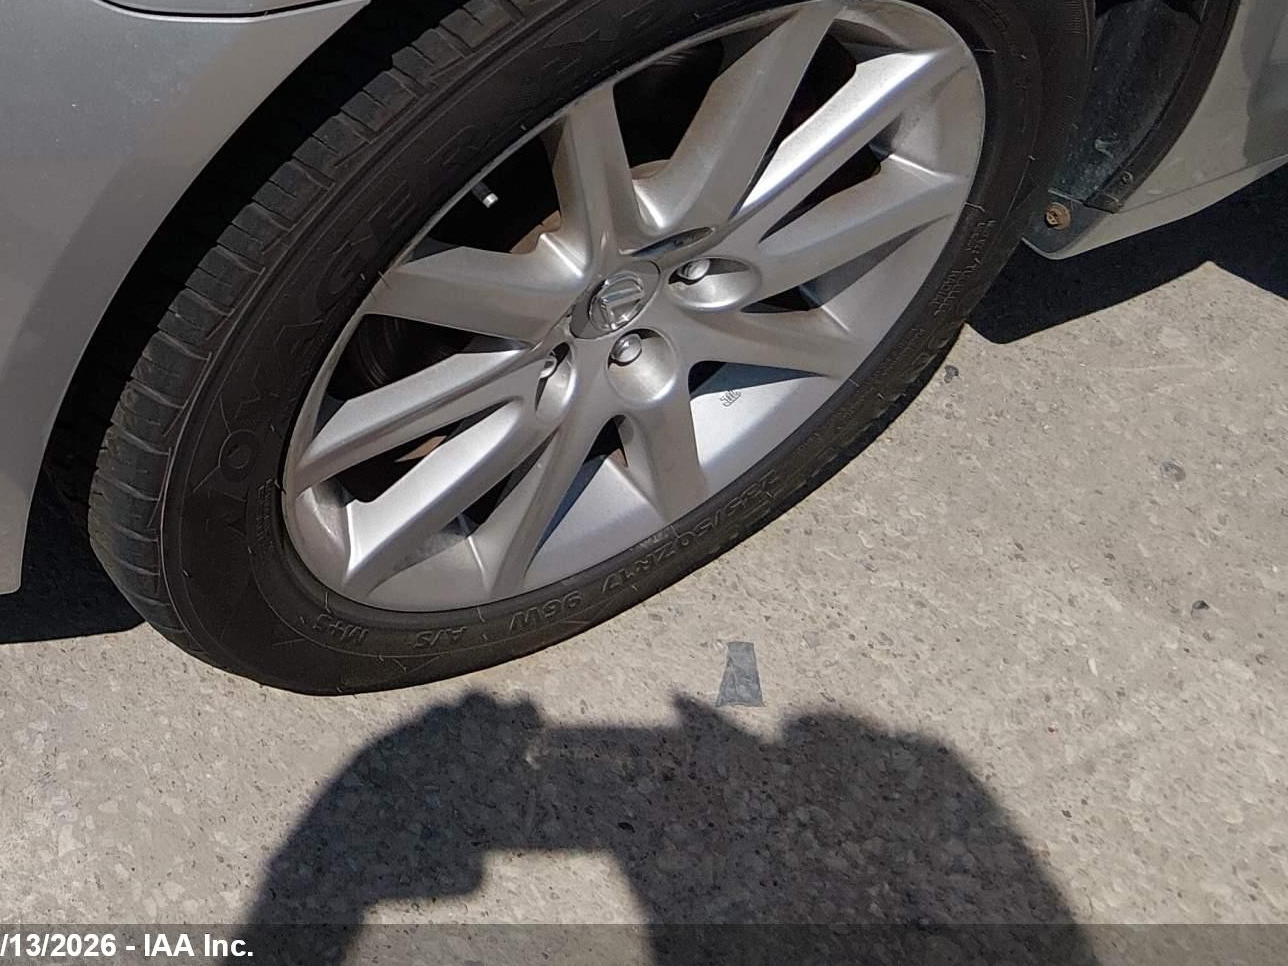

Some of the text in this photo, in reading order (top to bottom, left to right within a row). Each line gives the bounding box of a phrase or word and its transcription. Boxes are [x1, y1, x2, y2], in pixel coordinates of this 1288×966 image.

[504, 583, 584, 635] 96W
[304, 611, 375, 642] M+S
[405, 622, 470, 649] A/S
